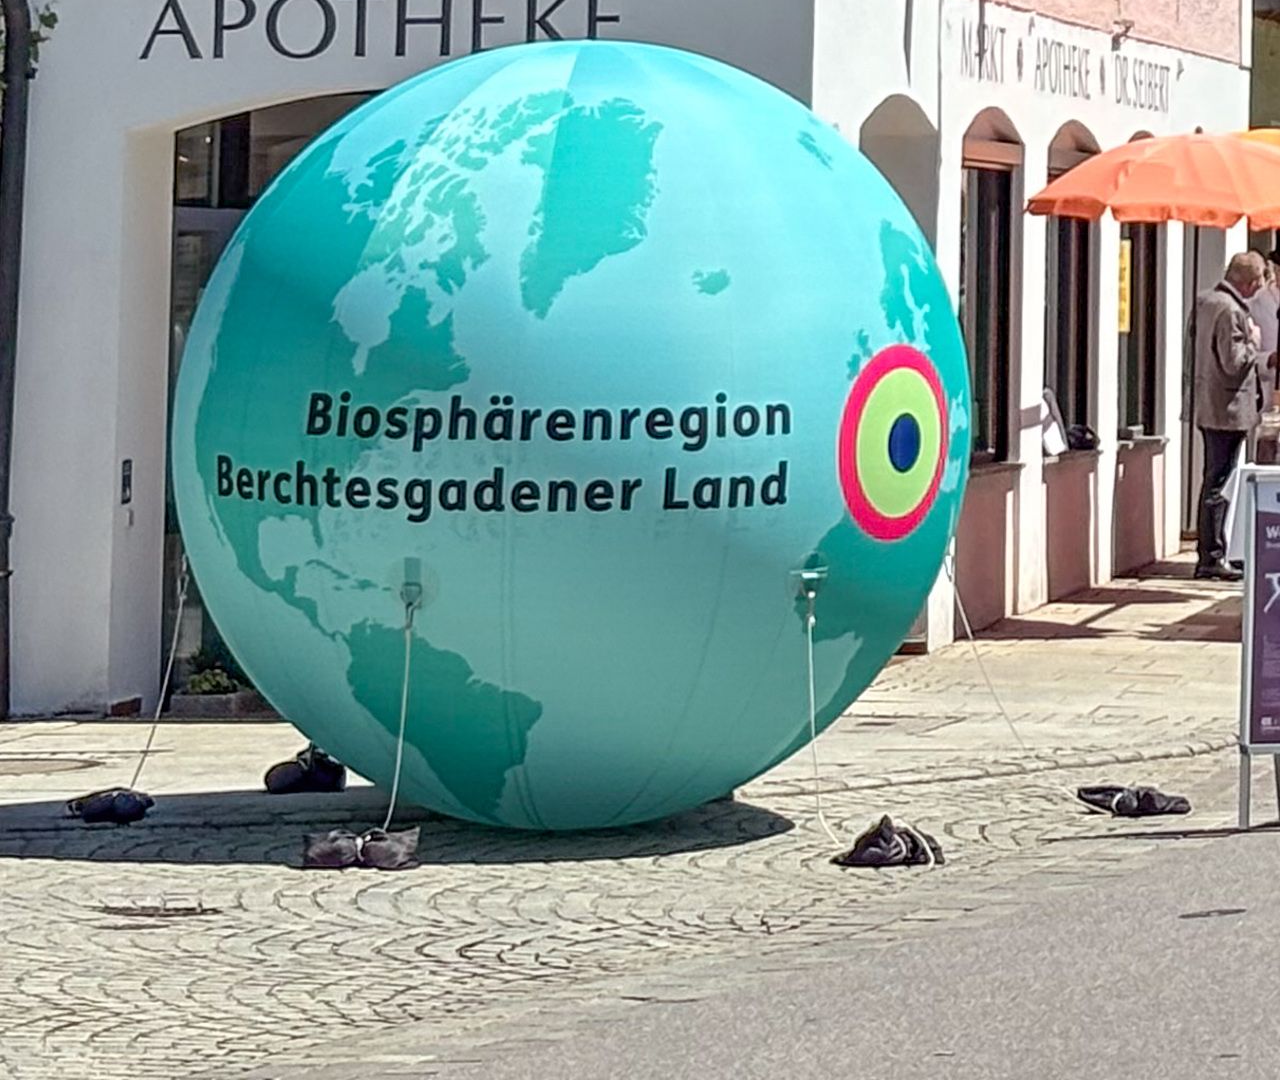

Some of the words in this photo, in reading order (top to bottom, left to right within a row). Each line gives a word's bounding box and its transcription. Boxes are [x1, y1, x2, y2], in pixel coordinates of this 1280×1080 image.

[961, 18, 1006, 83] MARKT
[1034, 36, 1091, 100] APOTHEKE
[306, 392, 792, 452] Biosphärenregion
[216, 455, 643, 522] Berchtesgadener
[662, 460, 789, 511] Land
